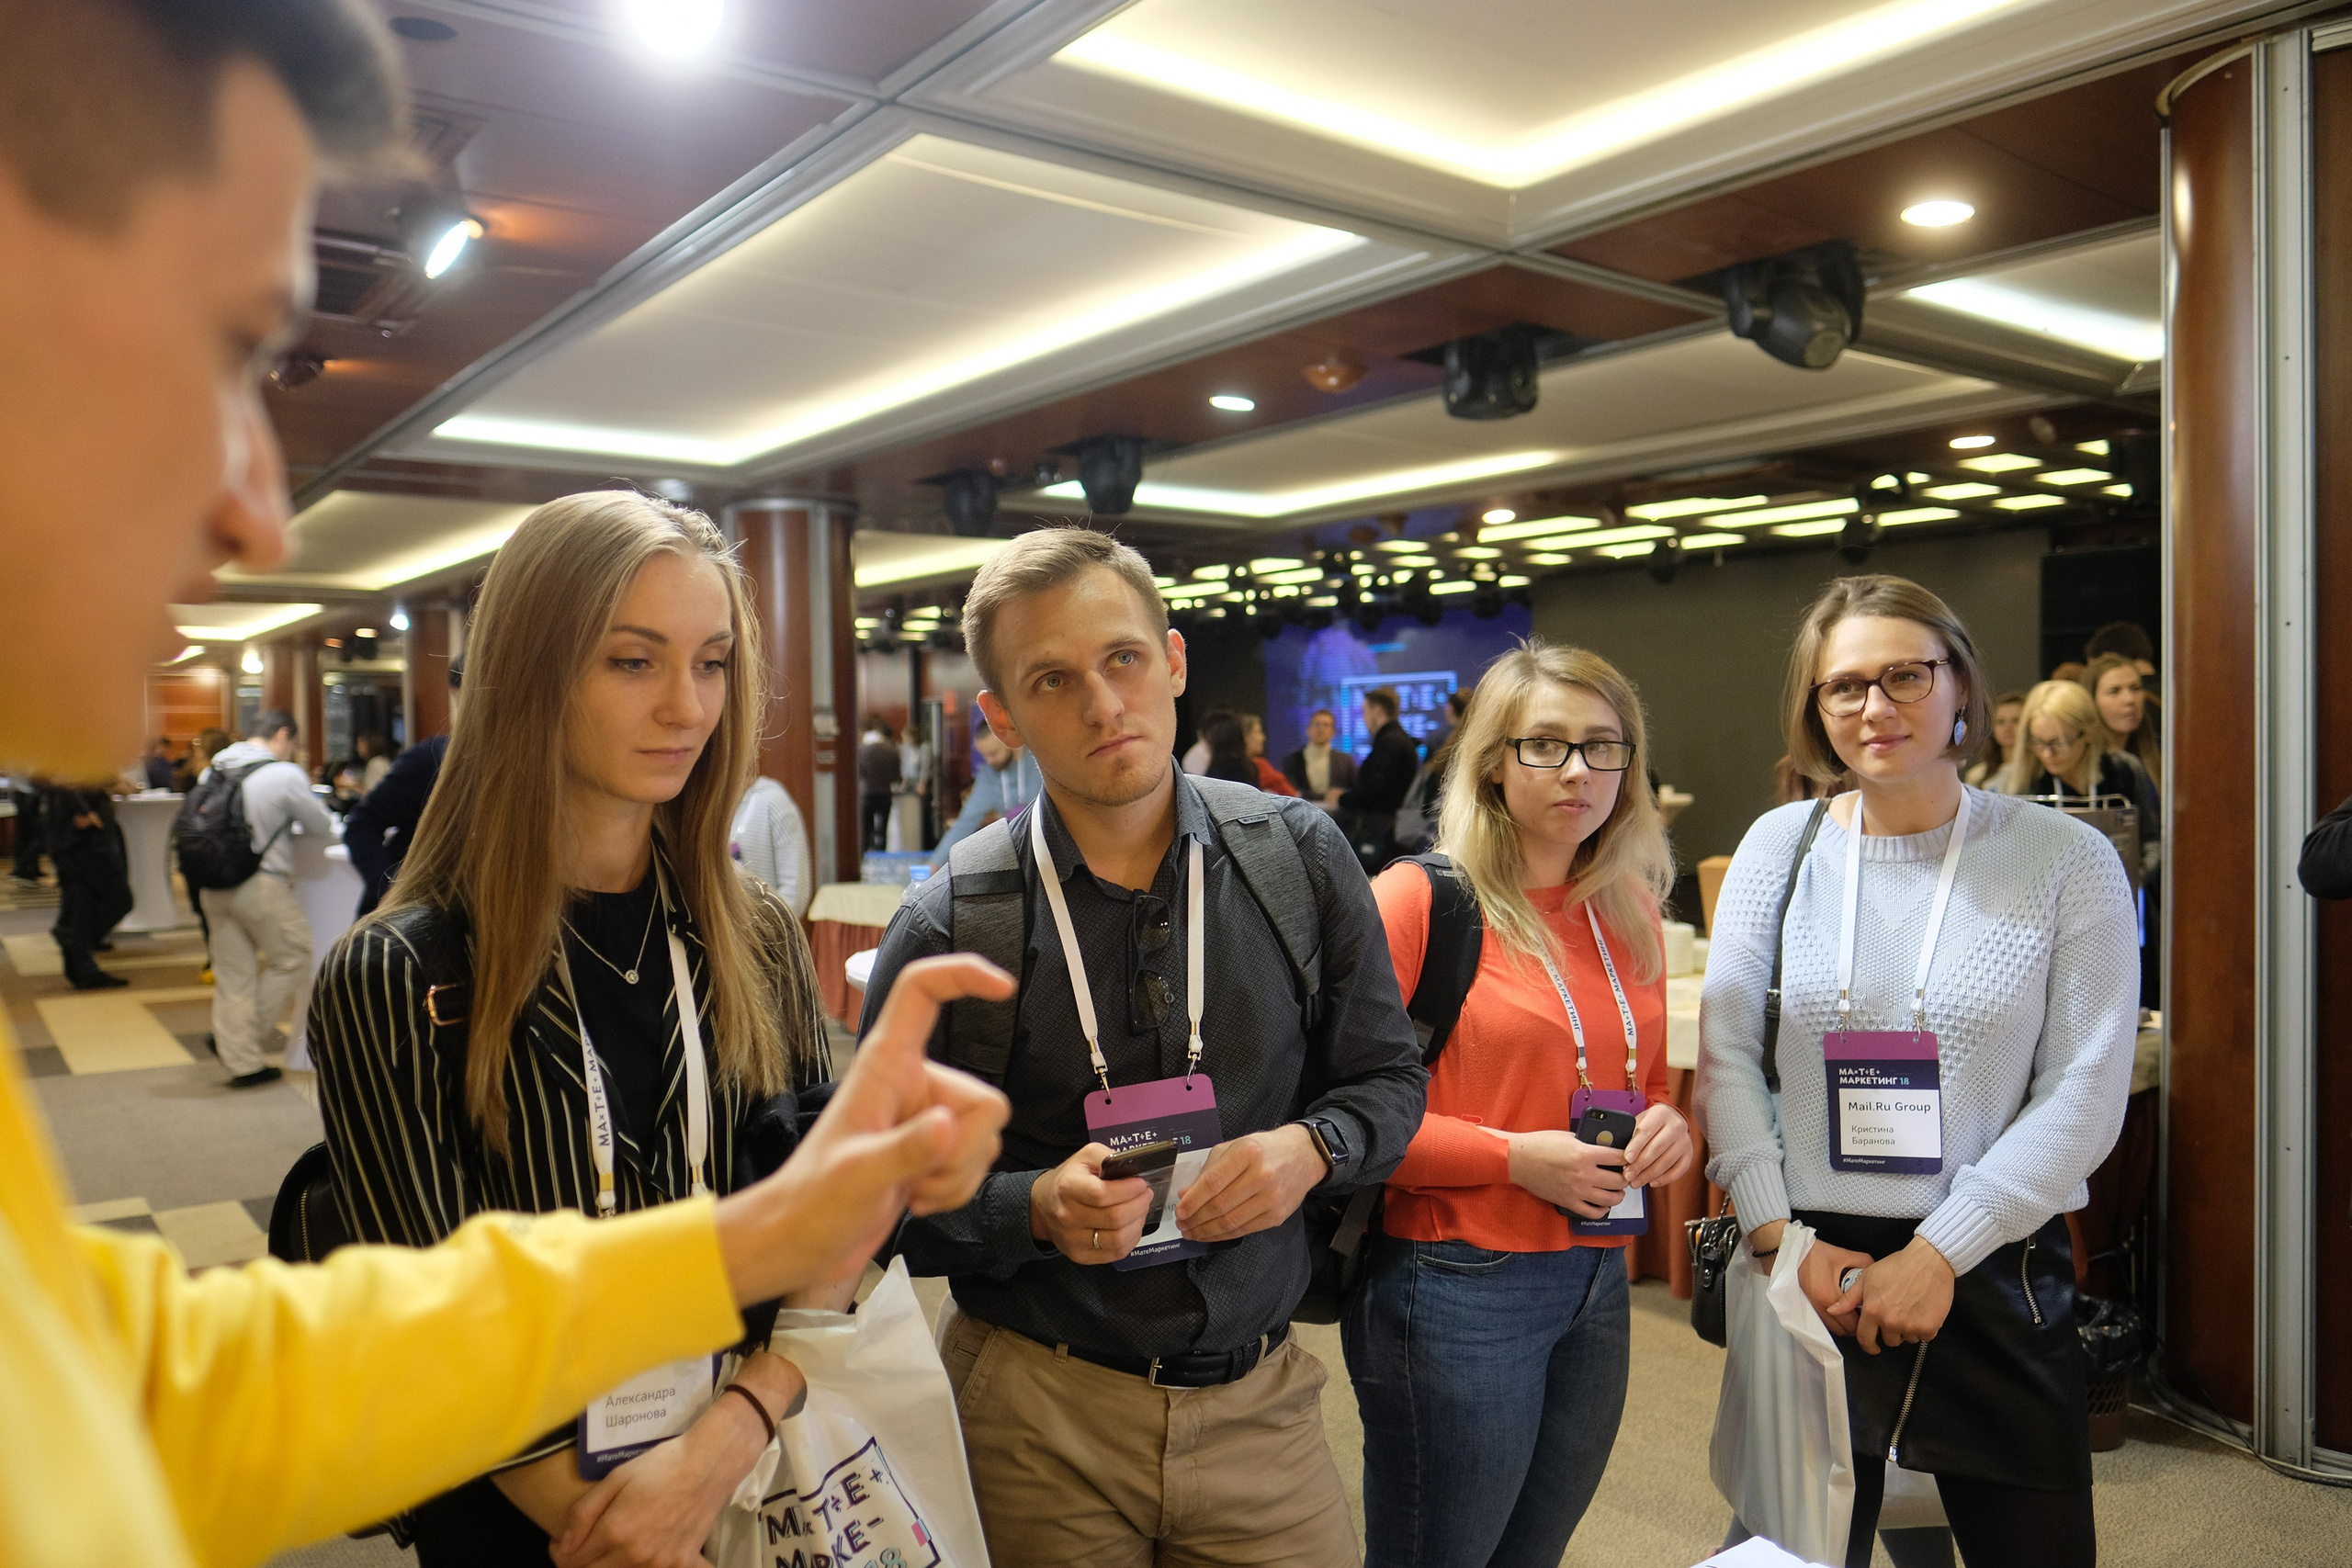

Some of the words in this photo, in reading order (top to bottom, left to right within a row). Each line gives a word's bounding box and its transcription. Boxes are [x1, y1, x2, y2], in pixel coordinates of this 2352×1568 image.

[1597, 937, 1622, 993] МАРКЕТИНГ
[1553, 974, 1580, 1032] МАРКЕТИНГ
[1839, 1077, 1898, 1085] МАРКЕТИНГ
[1899, 1077, 1909, 1085] 18
[1848, 1101, 1891, 1111] Mail.Ru
[1894, 1101, 1931, 1113] Group
[1851, 1125, 1894, 1134] Кристина
[1180, 1135, 1192, 1145] 18
[1852, 1136, 1895, 1145] Баранова
[1130, 1243, 1181, 1257] #МатеМаркетинг
[605, 1387, 675, 1408] Александра
[605, 1407, 666, 1428] Шаронова
